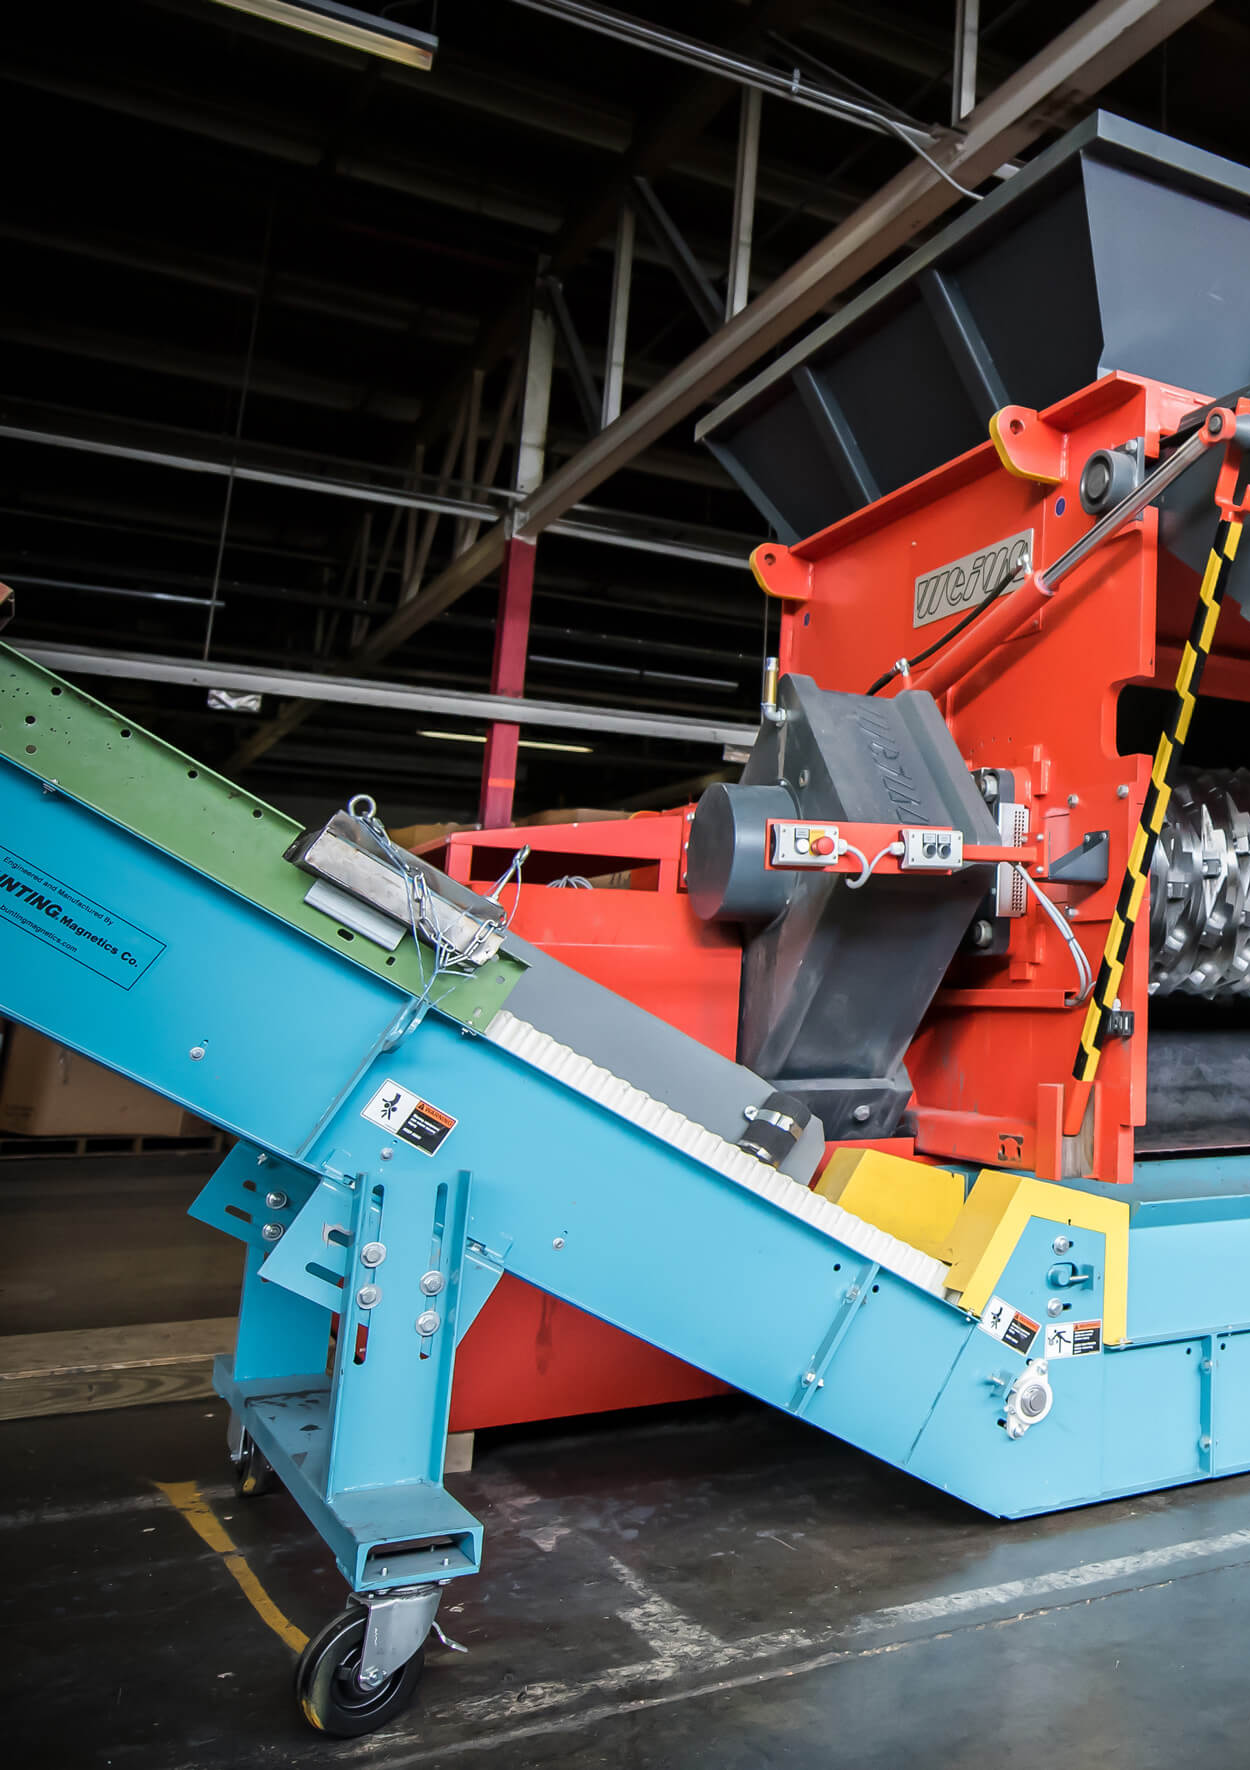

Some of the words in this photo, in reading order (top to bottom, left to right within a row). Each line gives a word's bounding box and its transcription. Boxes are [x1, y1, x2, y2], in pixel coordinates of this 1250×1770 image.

[3, 856, 44, 883] Engineered
[43, 881, 58, 892] and
[58, 889, 104, 919] Manufactured
[103, 917, 114, 926] By
[60, 915, 118, 954] Magnetics
[120, 951, 138, 968] Co.
[424, 1106, 453, 1127] WARNING
